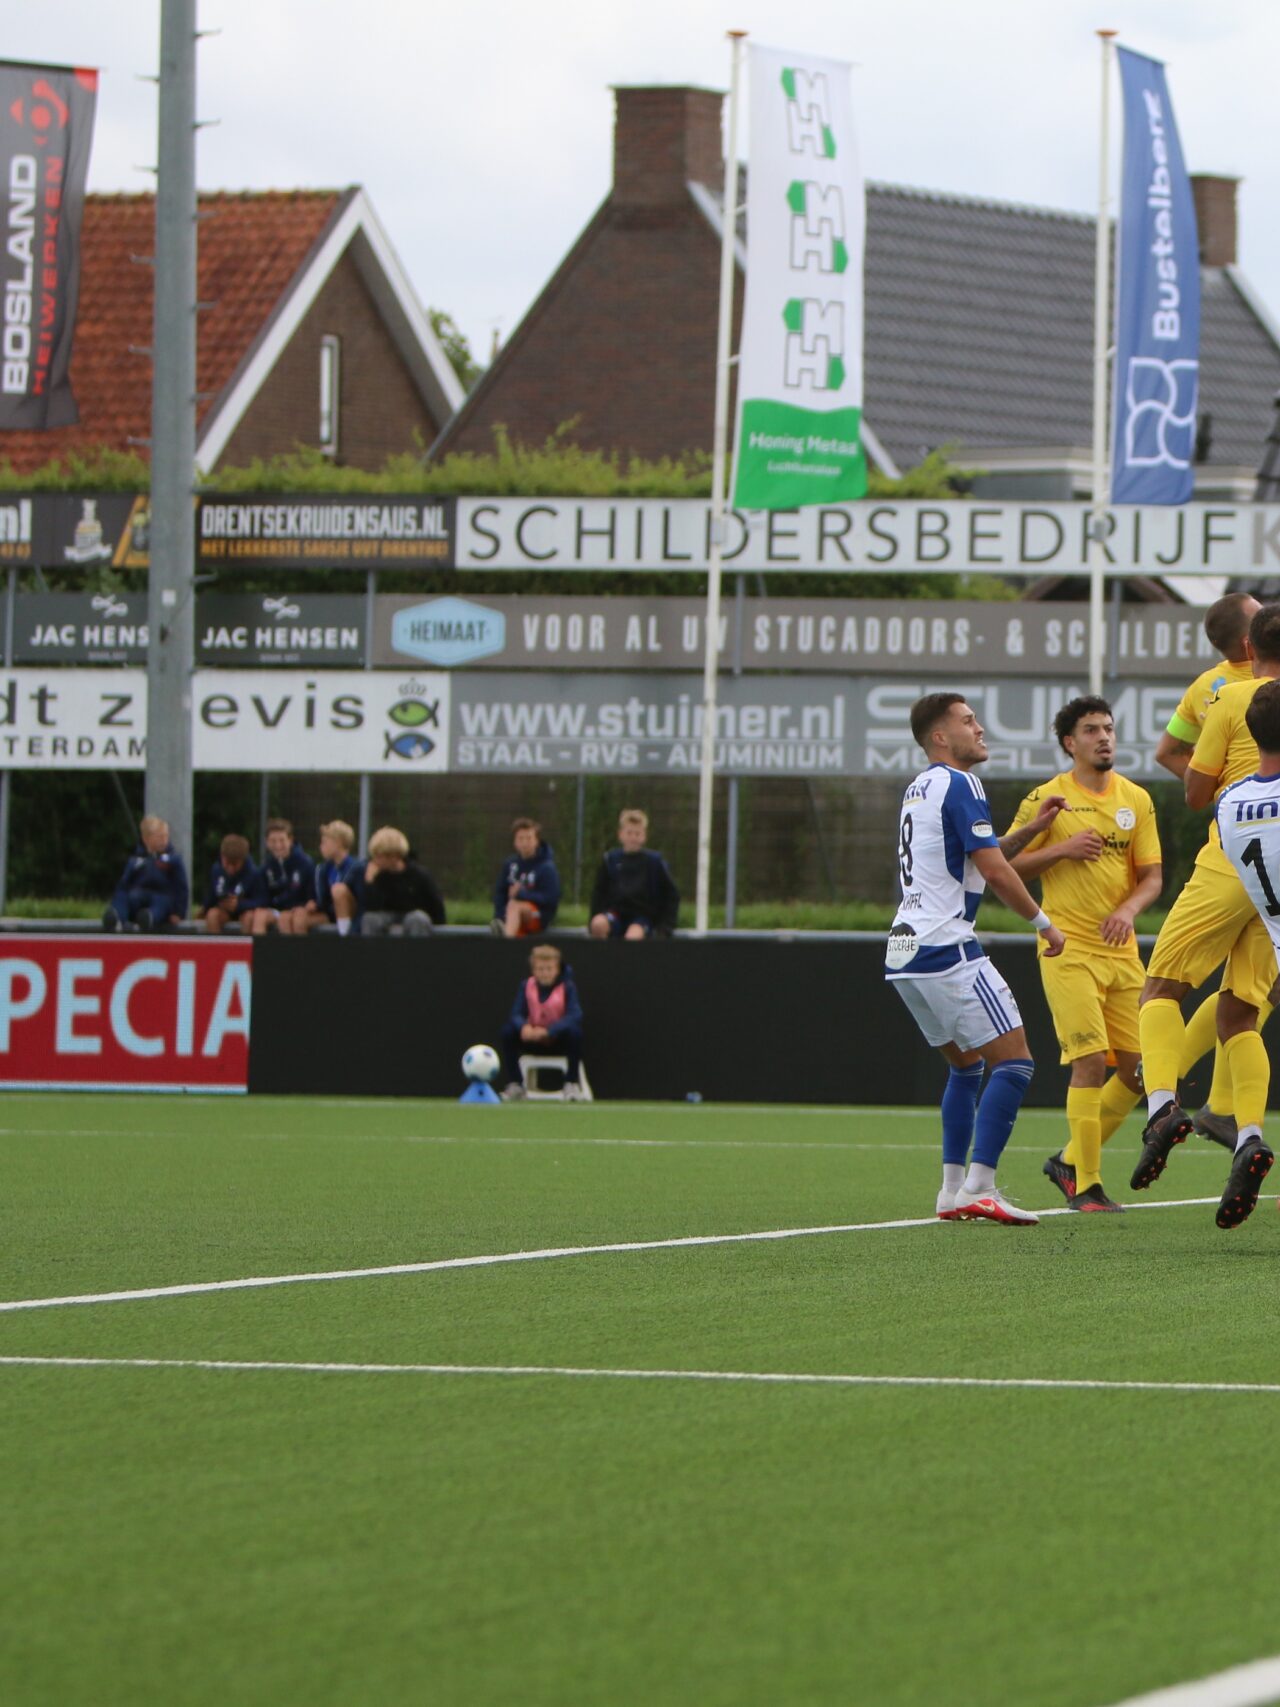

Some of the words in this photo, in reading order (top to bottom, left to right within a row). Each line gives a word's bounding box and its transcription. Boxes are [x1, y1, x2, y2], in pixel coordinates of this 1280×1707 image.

[2, 154, 38, 395] BOSLAND
[201, 504, 449, 538] DRENTSEKRUIDENSAUS.NL
[469, 505, 1237, 565] SCHILDERSBEDRIJF
[30, 624, 77, 647] JAC
[83, 624, 150, 647] HENS
[202, 625, 248, 649] JAC
[255, 626, 359, 649] HENSEN
[409, 620, 488, 643] HEIMAAT
[523, 613, 605, 653] VOOR
[625, 614, 662, 653] AL
[1005, 618, 1025, 657] &
[457, 743, 551, 767] STAAL
[580, 744, 640, 767] RVS
